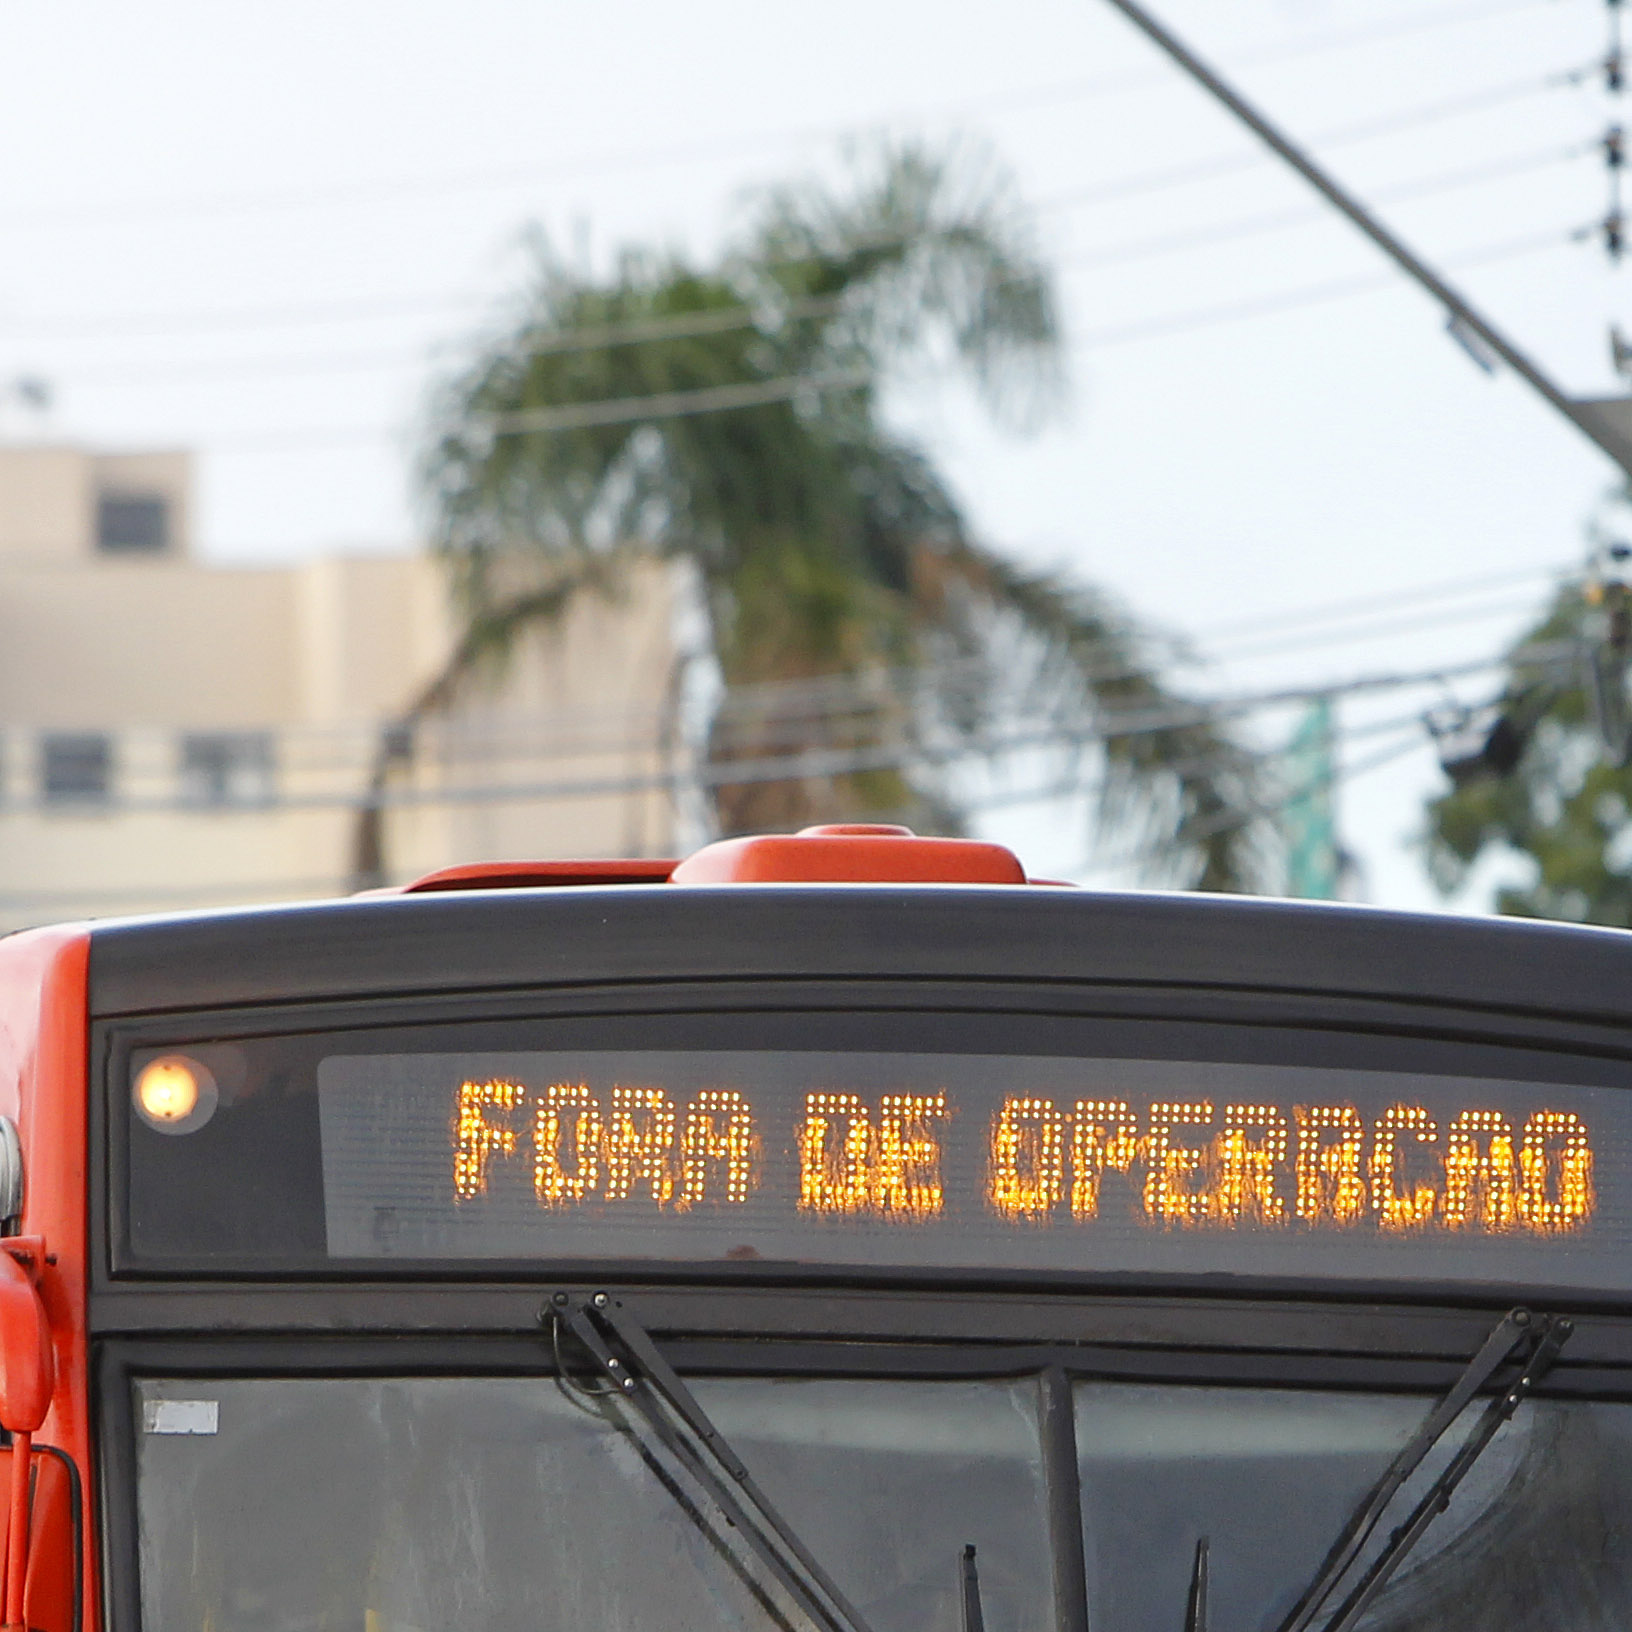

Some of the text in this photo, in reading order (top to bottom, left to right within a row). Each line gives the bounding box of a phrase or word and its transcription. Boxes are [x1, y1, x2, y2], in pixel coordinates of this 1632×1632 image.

[455, 1077, 1593, 1226] FORA DE OPERACAO
